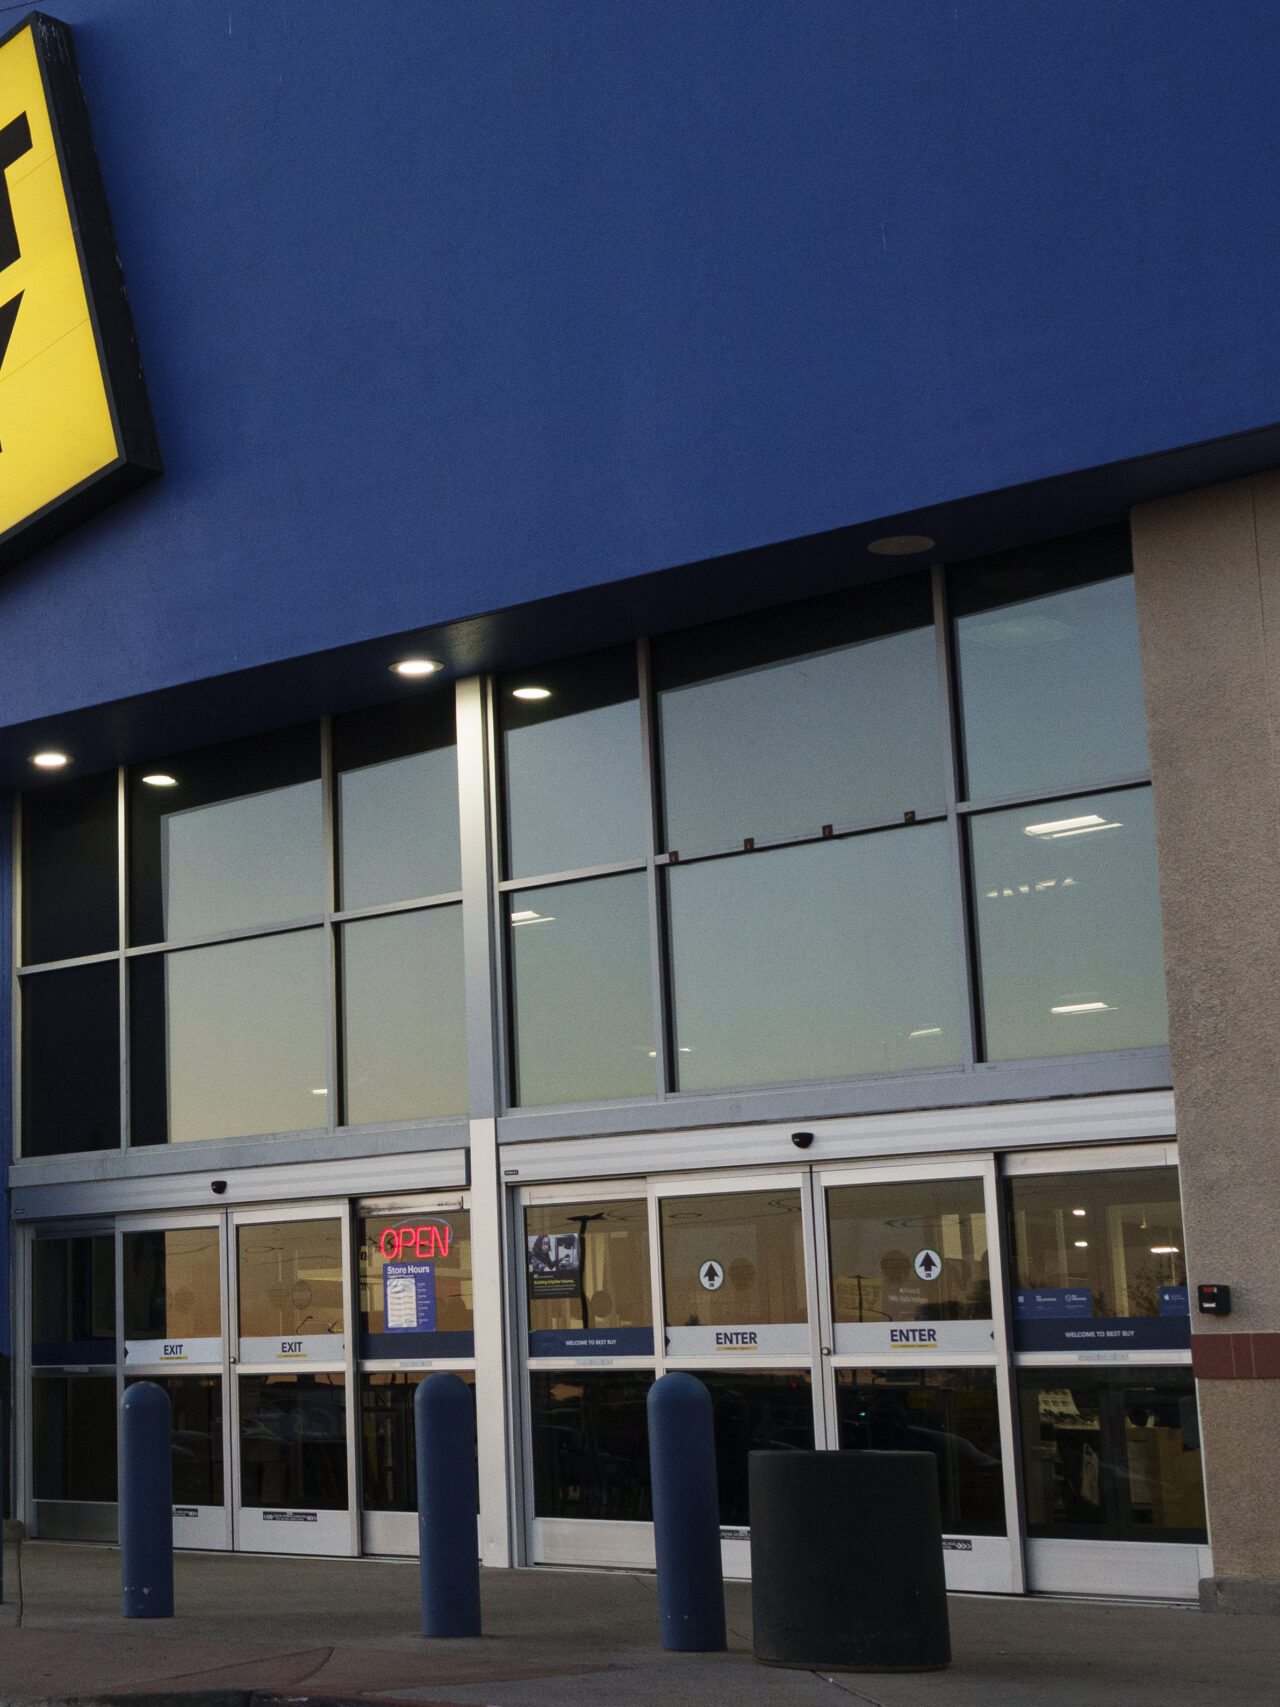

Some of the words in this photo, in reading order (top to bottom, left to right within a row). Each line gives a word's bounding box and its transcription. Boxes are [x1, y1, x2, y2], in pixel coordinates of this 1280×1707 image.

[379, 1225, 450, 1259] OPEN
[387, 1266, 407, 1275] Store
[407, 1265, 430, 1274] Hours
[715, 1331, 758, 1345] ENTER
[890, 1328, 937, 1342] ENTER
[163, 1344, 184, 1356] EXIT
[281, 1341, 303, 1353] EXIT
